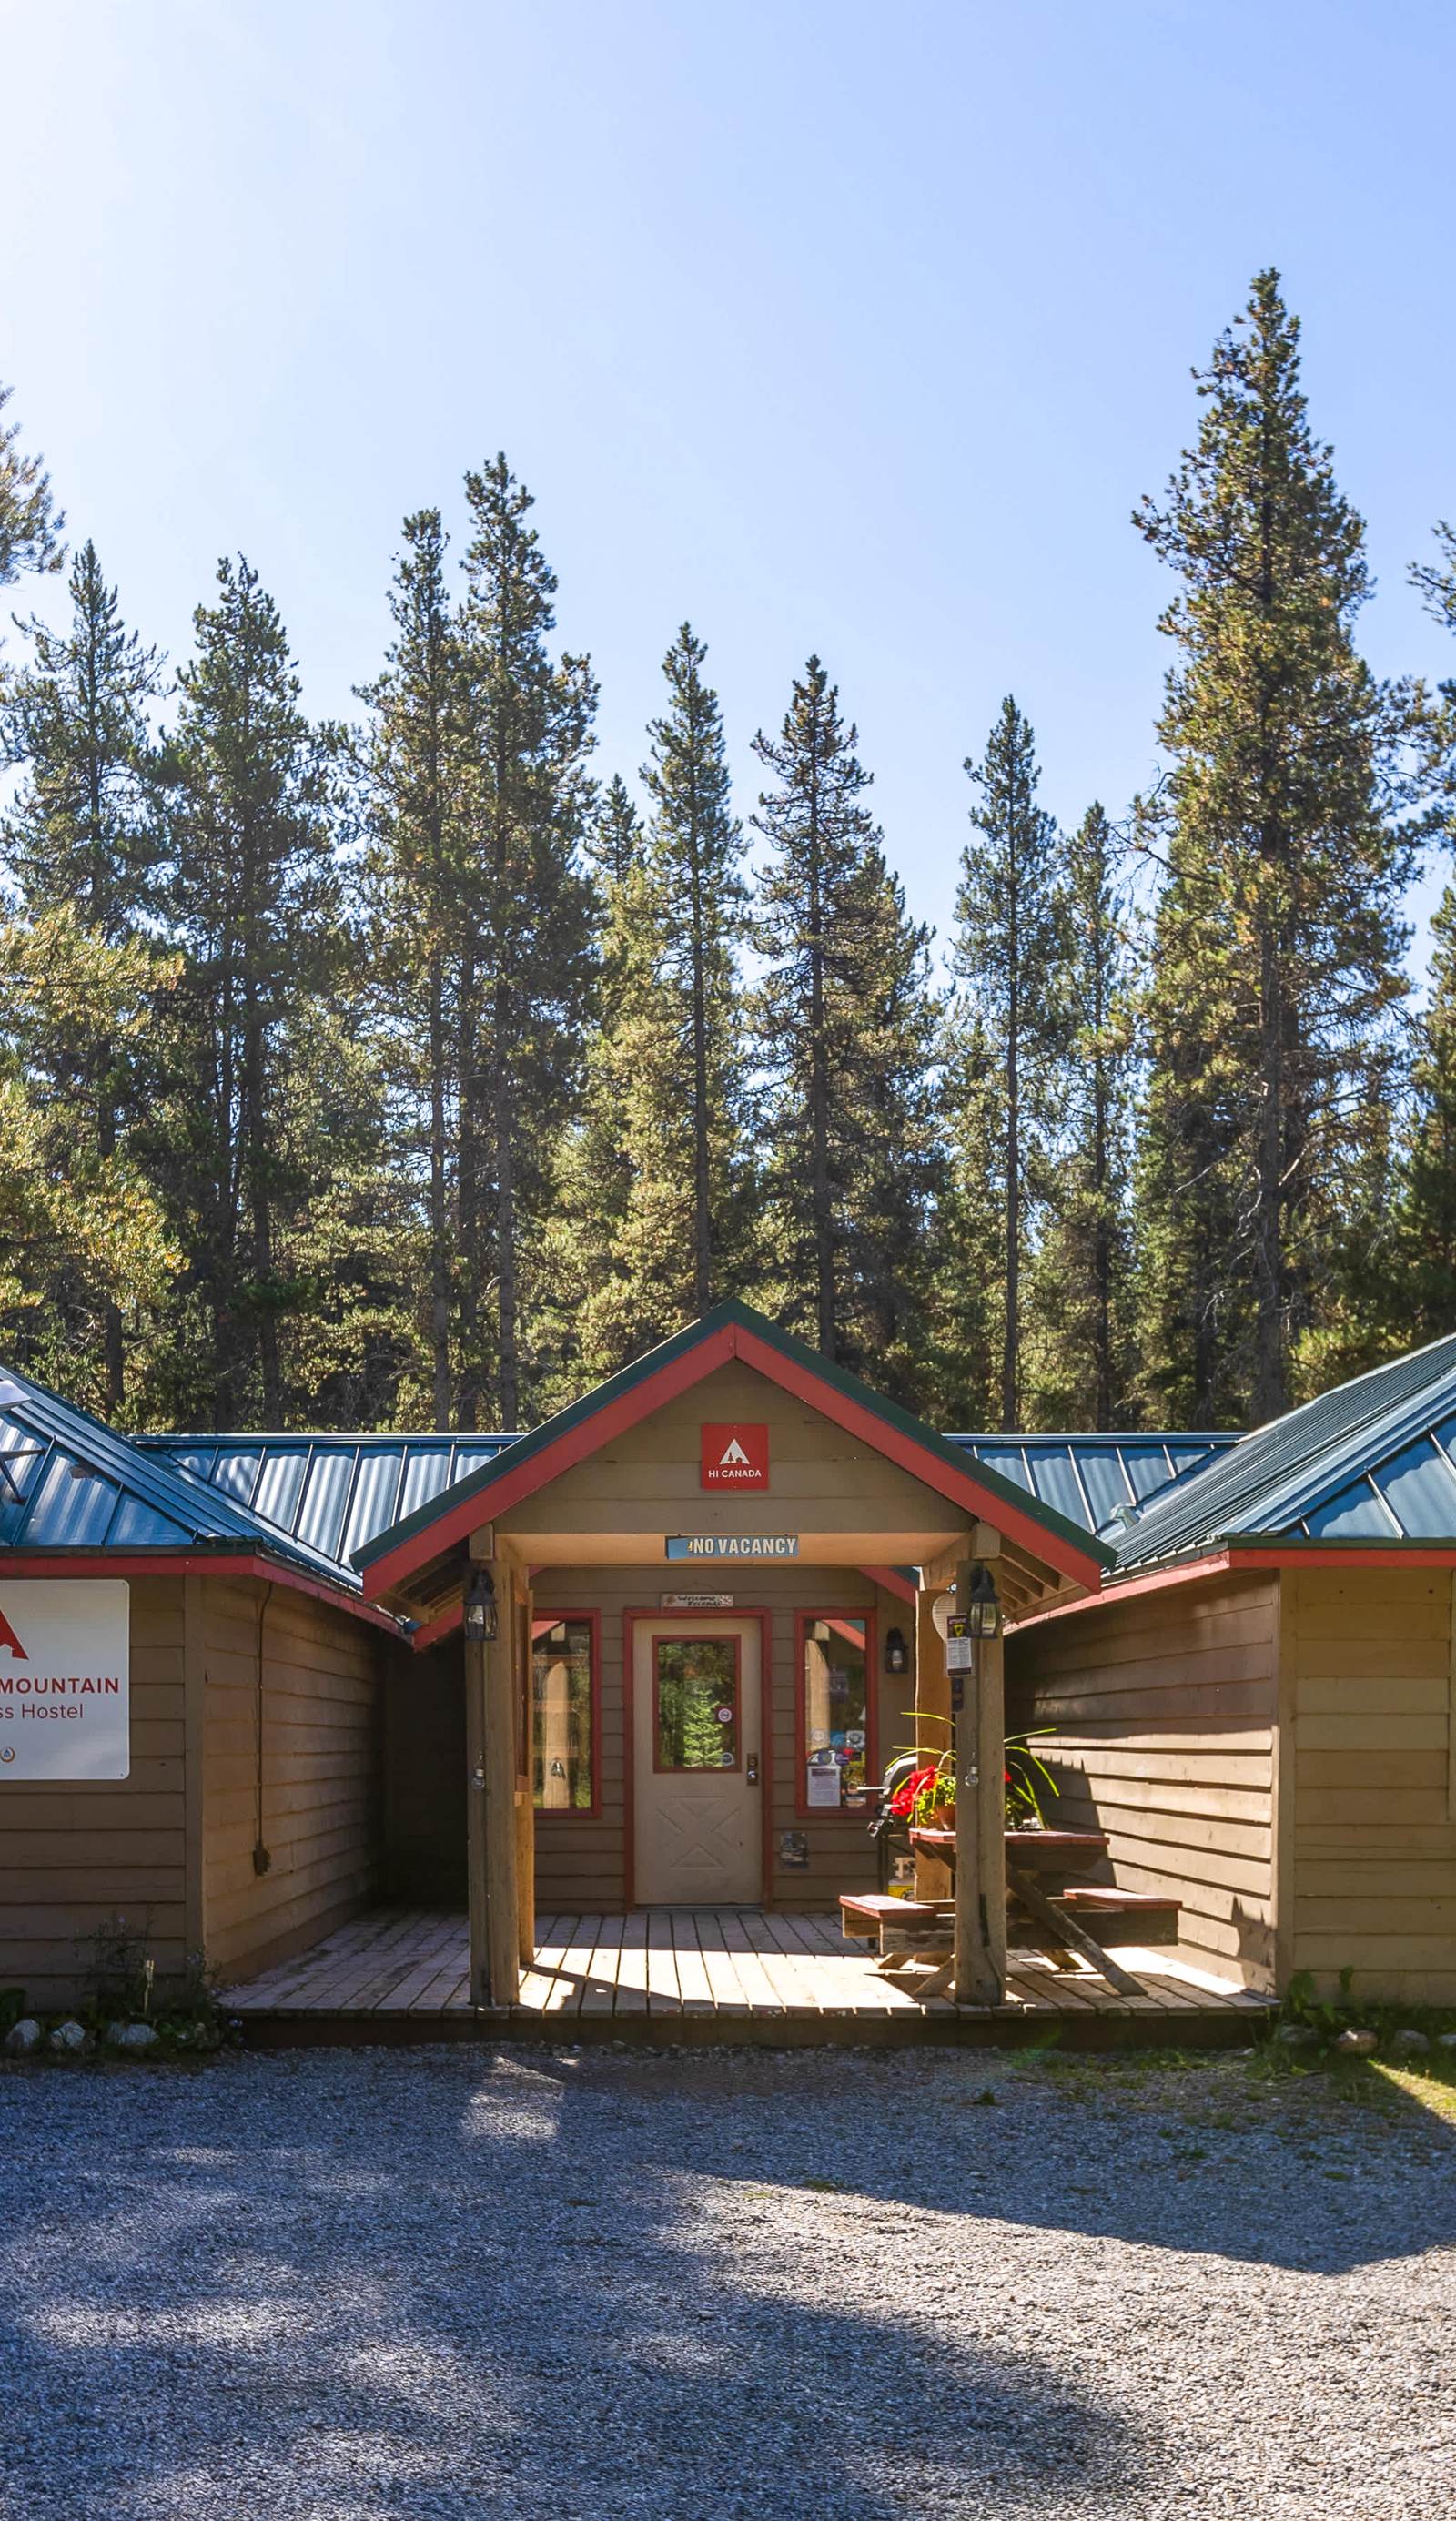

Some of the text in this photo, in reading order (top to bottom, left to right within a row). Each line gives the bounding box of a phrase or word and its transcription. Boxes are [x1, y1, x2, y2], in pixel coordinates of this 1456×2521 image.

[708, 1469, 762, 1478] HI CANADA
[693, 1538, 796, 1554] NO VACANCY
[0, 1677, 119, 1693] MOUNTAIN
[22, 1704, 84, 1719] Hostel
